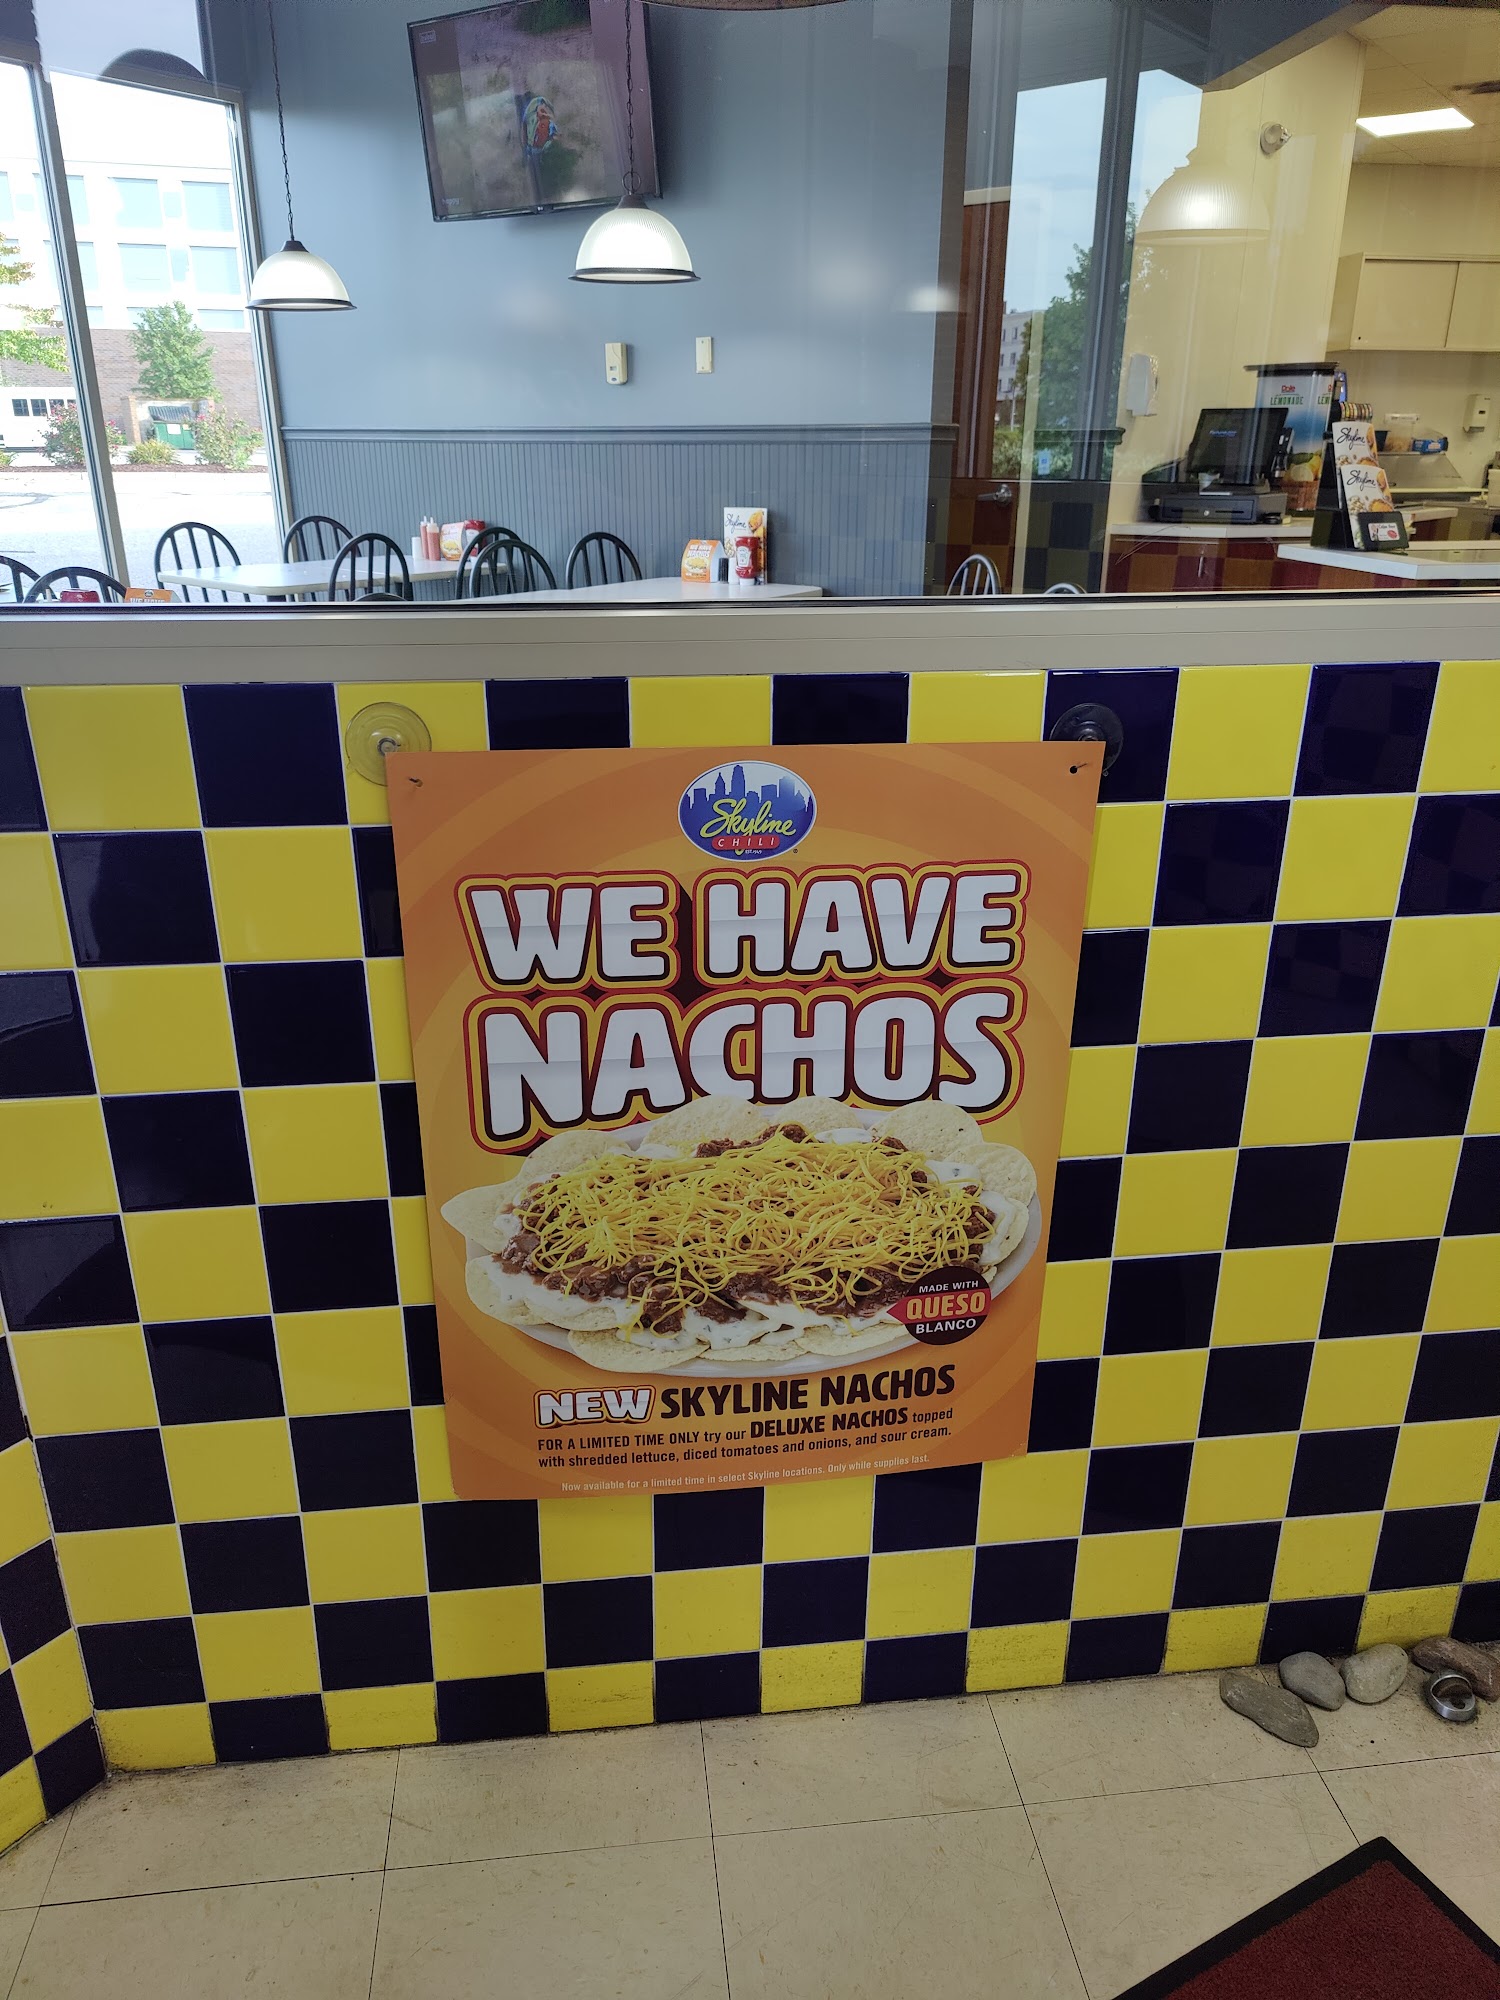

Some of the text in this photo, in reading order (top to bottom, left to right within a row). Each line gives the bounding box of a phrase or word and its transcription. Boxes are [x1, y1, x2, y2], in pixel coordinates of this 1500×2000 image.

[1270, 396, 1304, 406] LEMONADE
[1281, 384, 1296, 393] Dole
[1336, 427, 1366, 450] Skyline
[1346, 469, 1376, 491] Skyline
[724, 513, 747, 534] Skyline
[700, 797, 797, 856] Skyline
[717, 836, 776, 848] CHILI
[466, 872, 1020, 984] WE HAVE
[479, 991, 1013, 1141] NACHOS
[919, 1280, 979, 1294] MADE WITH
[906, 1292, 985, 1320] QUESO
[916, 1318, 976, 1334] BLANCO
[536, 1364, 956, 1428] NEW SKYLINE NACHOS
[537, 1407, 953, 1451] FOR A LIMITED TIME ONLY try our DELUXE NACHOS topped
[538, 1427, 952, 1467] with shredded lettuce, diced tomatoes and onions, and sour cream.
[561, 1454, 930, 1492] Now available for a limited time in select Skyline locations. Only while supplies last.
